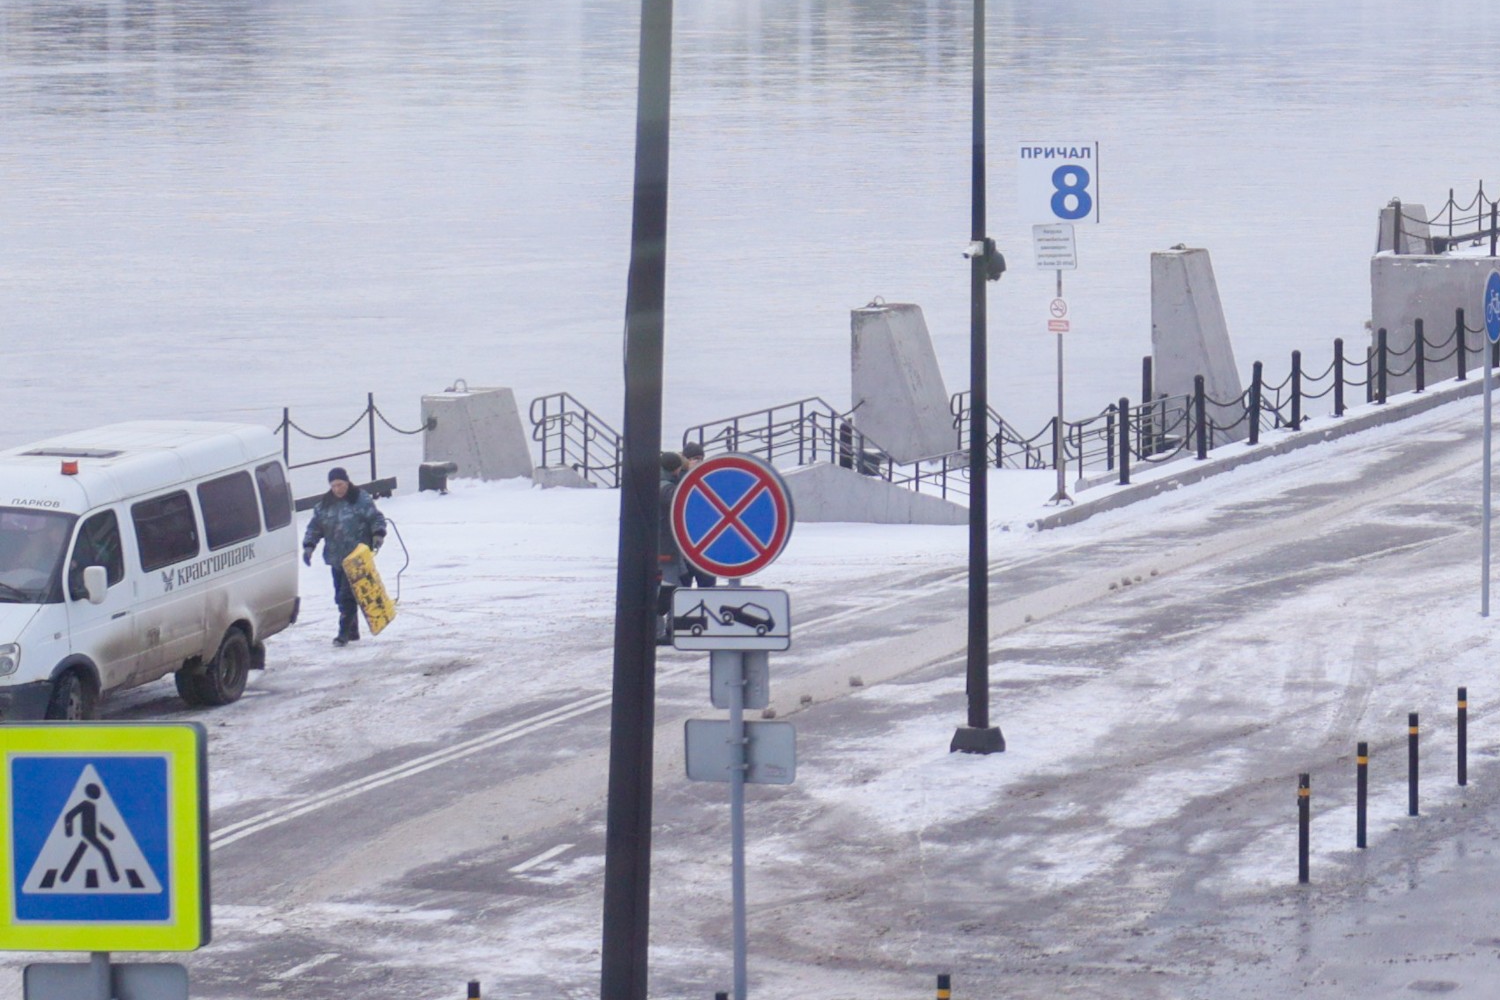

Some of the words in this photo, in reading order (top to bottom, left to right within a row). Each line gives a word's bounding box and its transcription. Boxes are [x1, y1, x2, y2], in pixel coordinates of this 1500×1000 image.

[1020, 147, 1091, 159] ПРИЧАЛ
[1050, 164, 1092, 220] 8
[11, 498, 60, 508] ПАРКОВ
